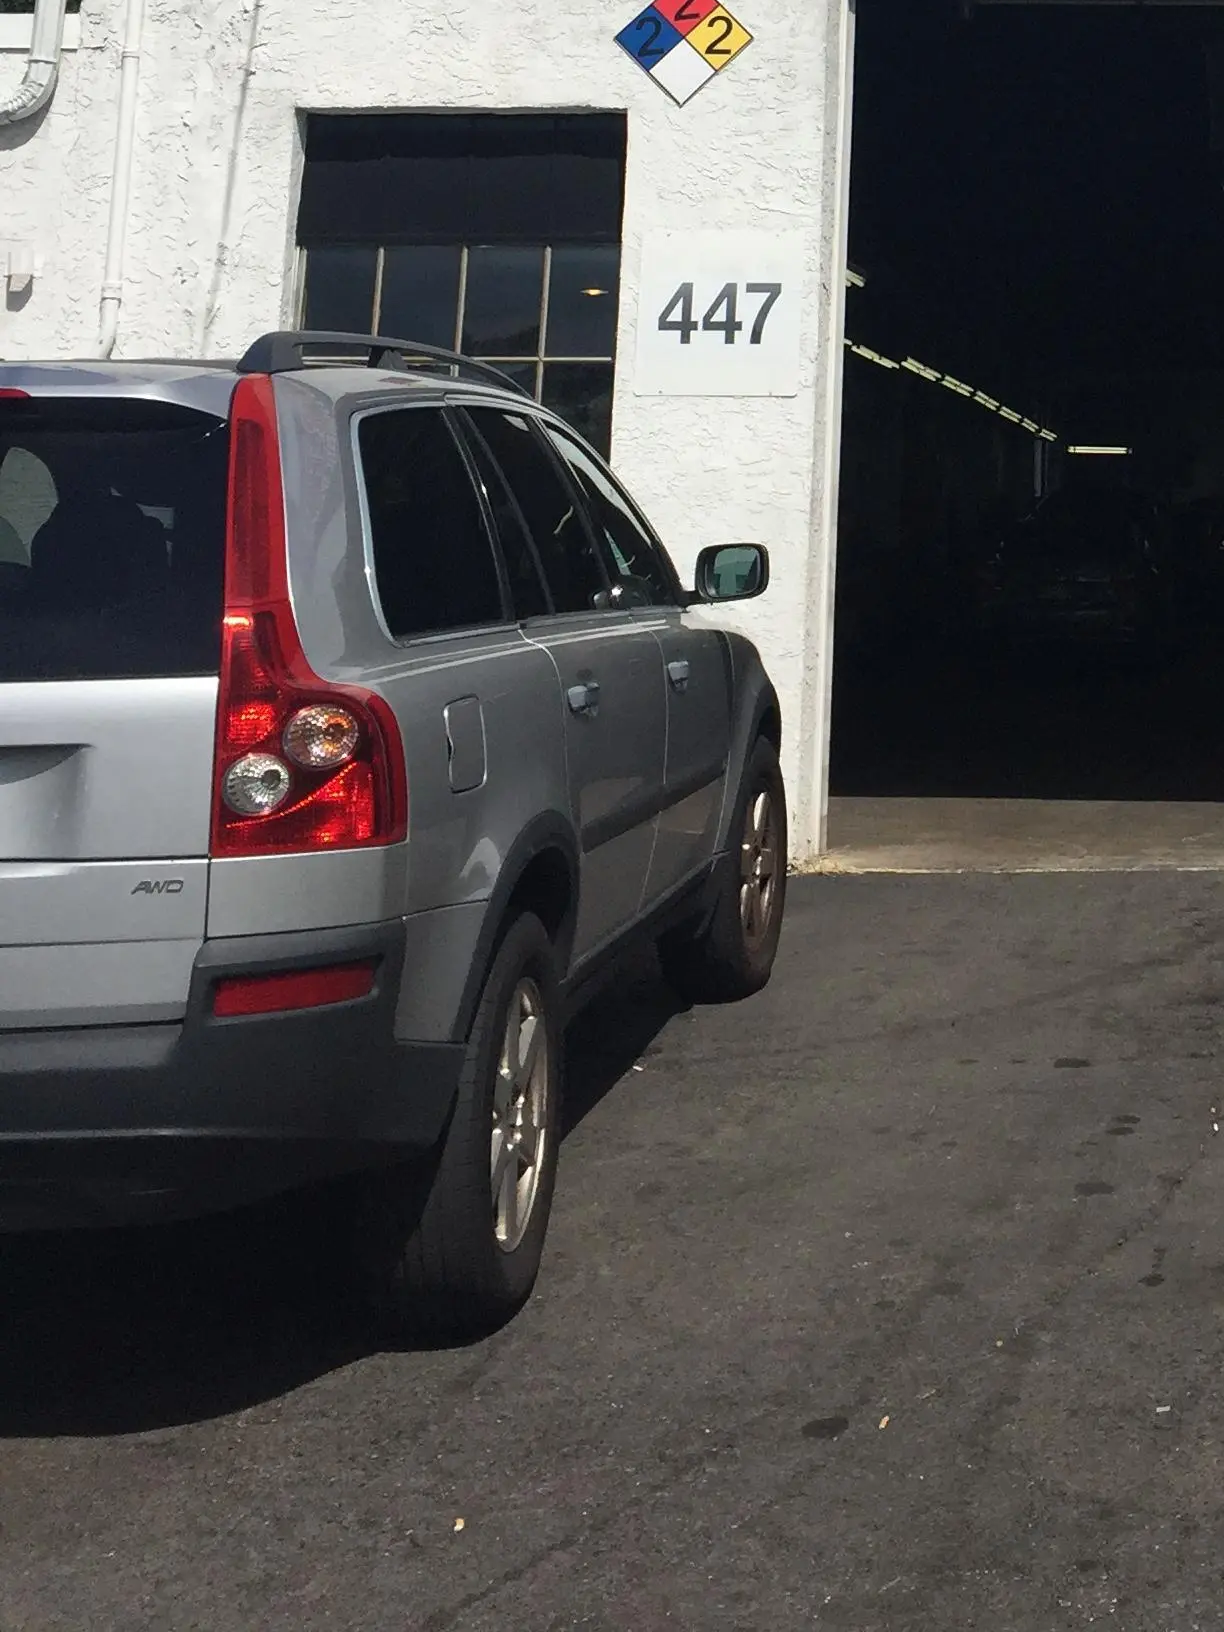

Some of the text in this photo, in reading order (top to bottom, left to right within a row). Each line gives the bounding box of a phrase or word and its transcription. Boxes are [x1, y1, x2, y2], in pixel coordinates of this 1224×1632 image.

[635, 16, 666, 57] 2
[704, 15, 735, 56] 2
[657, 282, 783, 345] 447
[130, 879, 184, 895] AWD
